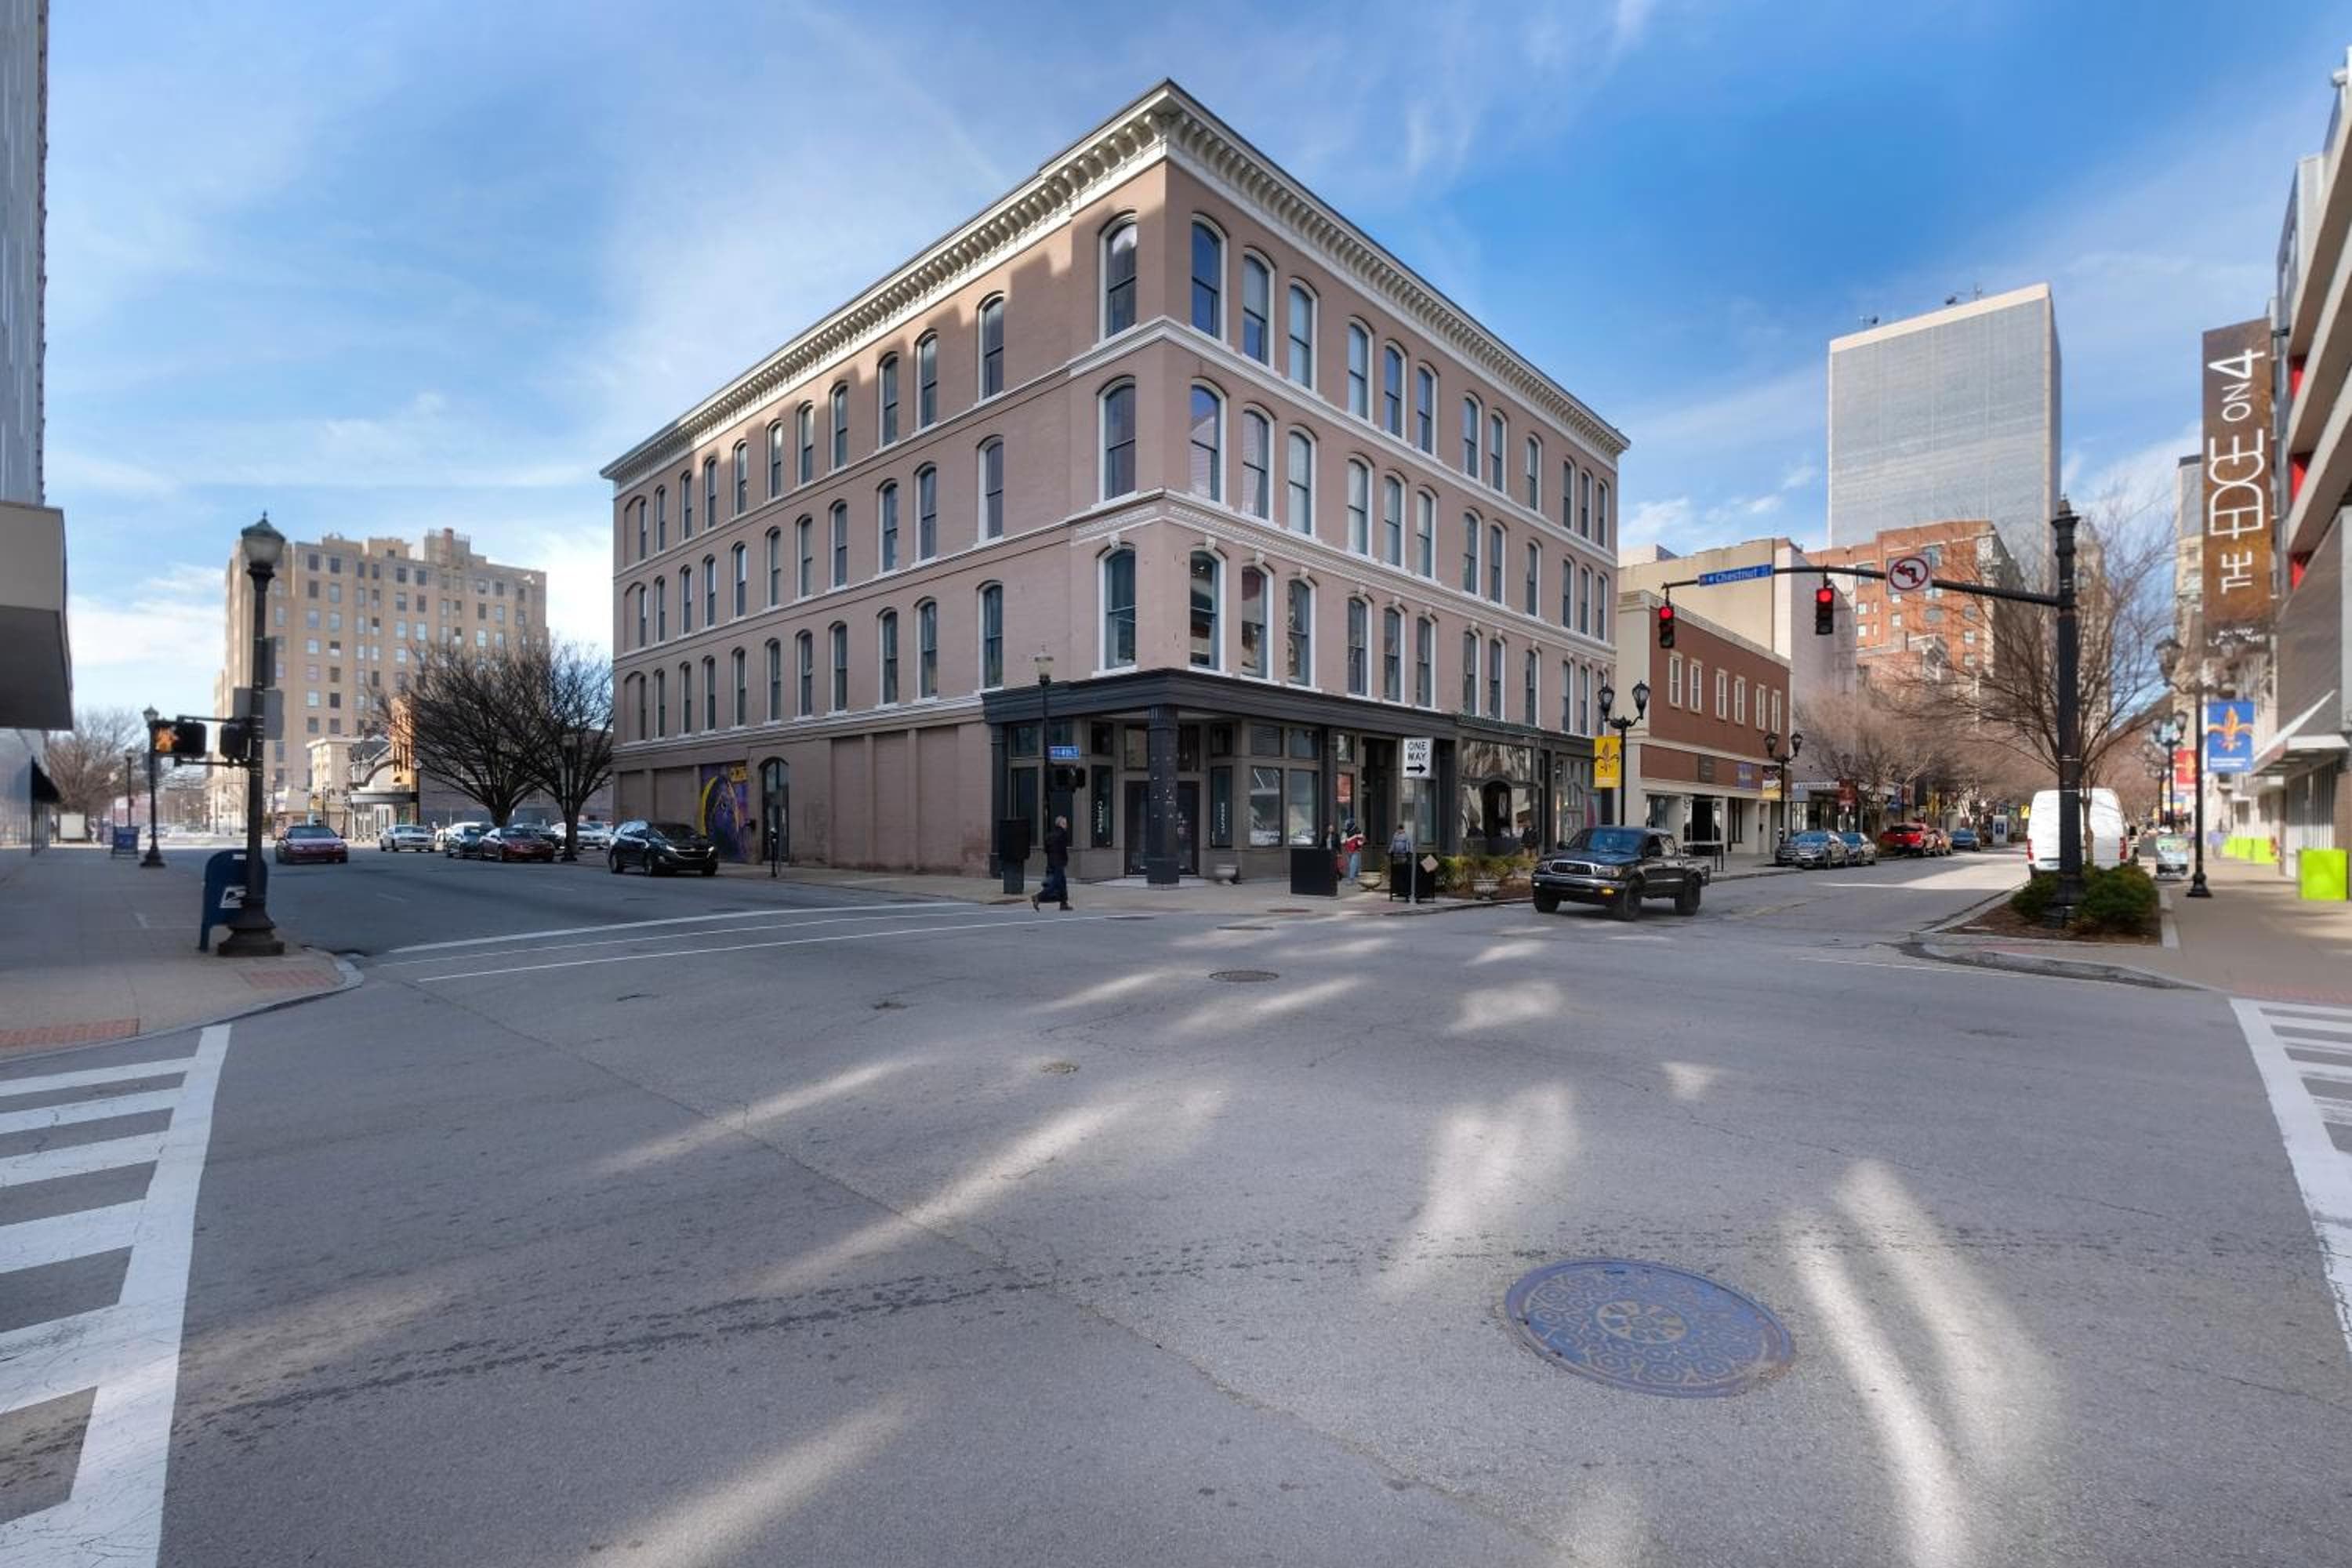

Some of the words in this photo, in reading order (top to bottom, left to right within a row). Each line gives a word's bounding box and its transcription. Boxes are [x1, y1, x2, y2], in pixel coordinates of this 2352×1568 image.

[2207, 428, 2265, 539] EDGE
[1715, 568, 1757, 583] Chestnut
[2220, 551, 2252, 594] THE
[1407, 742, 1426, 750] ONE
[1407, 752, 1427, 760] WAY
